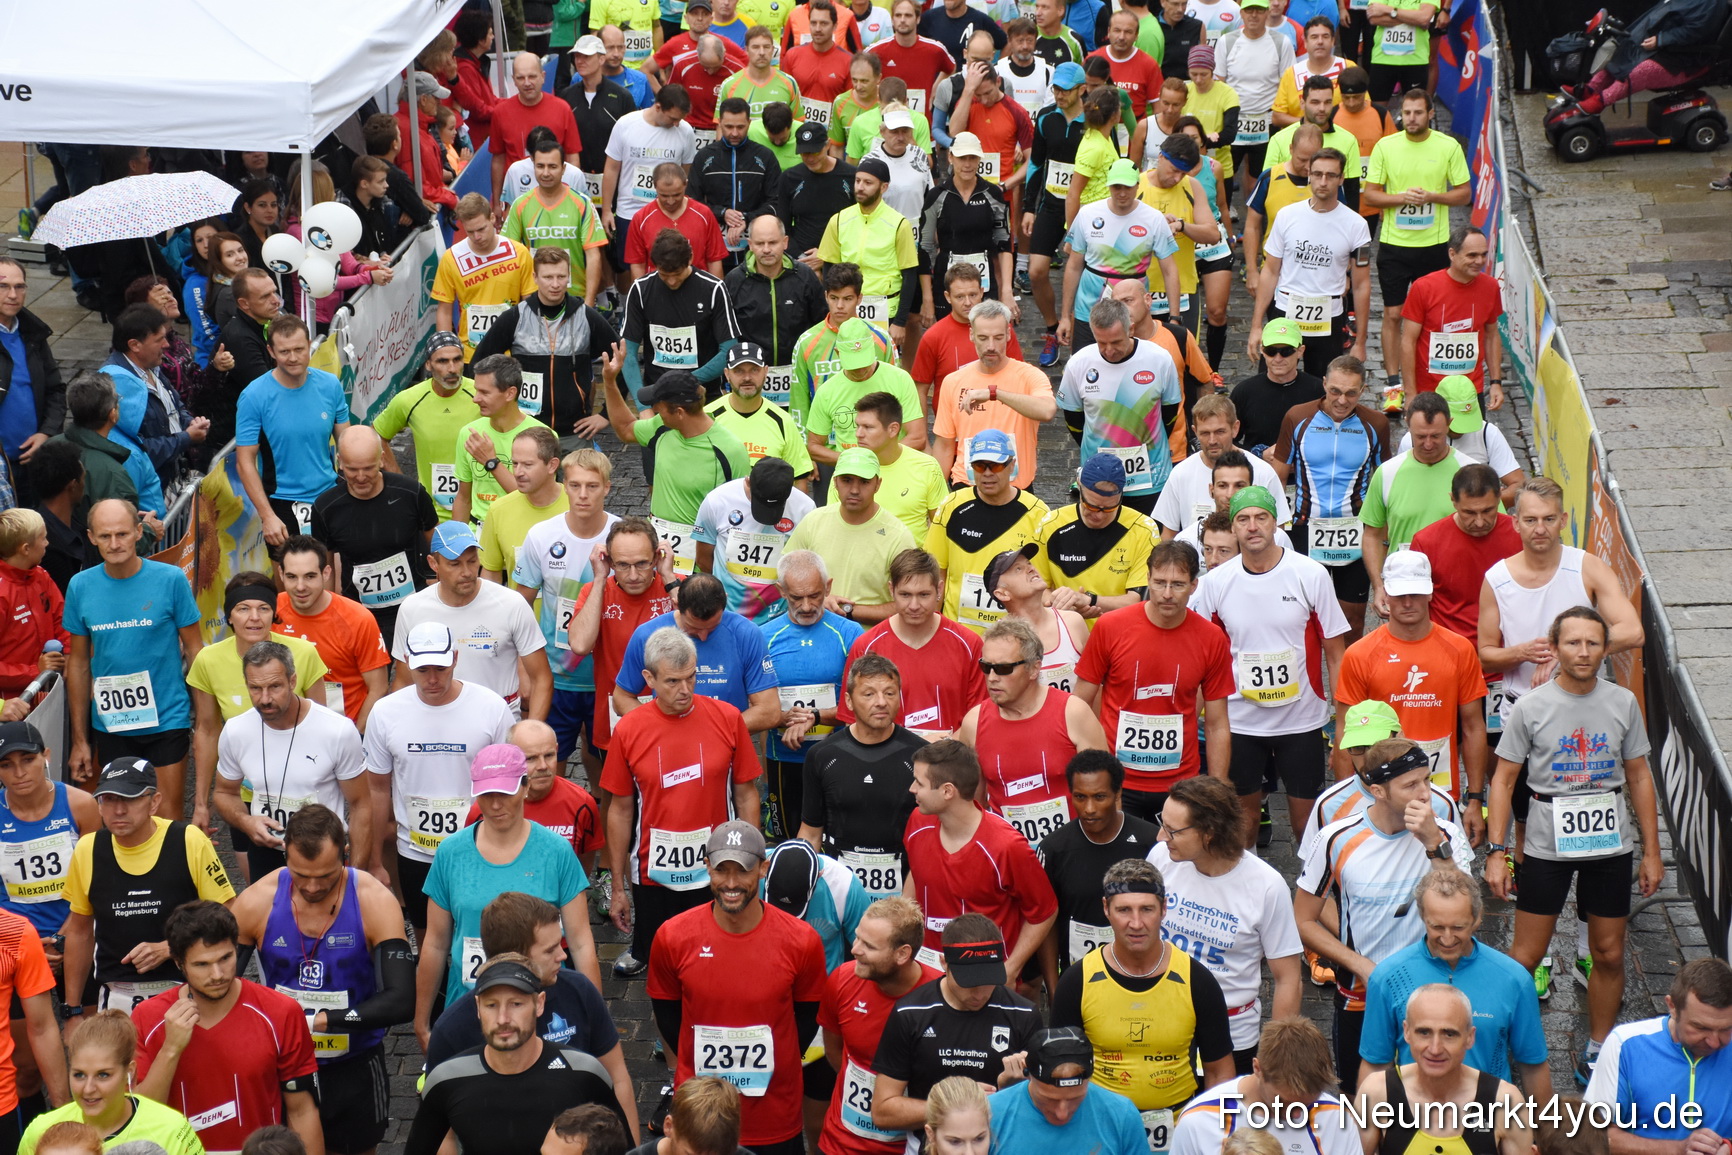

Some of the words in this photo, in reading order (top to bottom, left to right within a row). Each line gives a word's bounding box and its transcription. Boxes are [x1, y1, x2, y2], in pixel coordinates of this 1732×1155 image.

[626, 37, 651, 51] 2905
[1385, 30, 1414, 44] 3054
[804, 106, 827, 123] 896
[1236, 119, 1266, 132] 2428
[977, 161, 993, 176] 89
[586, 180, 600, 196] 73
[636, 174, 654, 189] 28
[526, 225, 577, 240] BOCK
[463, 272, 490, 288] MAX
[492, 261, 520, 277] BÖGL
[858, 304, 876, 320] 80
[1294, 304, 1322, 321] 272
[654, 335, 694, 353] 2854
[1435, 343, 1475, 360] 2668
[814, 359, 842, 376] BO
[1440, 361, 1466, 371] Edmund
[520, 384, 539, 401] 60
[744, 441, 767, 453] ller
[1124, 456, 1145, 473] 02
[437, 475, 459, 493] 25
[961, 527, 983, 538] Peter
[1314, 528, 1360, 548] 2752
[737, 543, 774, 565] 347
[1059, 553, 1087, 563] Markus
[1322, 550, 1351, 560] Thomas
[360, 565, 407, 594] 2713
[743, 567, 762, 578] Sepp
[377, 590, 401, 603] Marco
[977, 611, 998, 622] Peter
[91, 617, 153, 632] www.hasit.de
[1250, 664, 1290, 687] 313
[99, 685, 150, 711] 3069
[1258, 689, 1286, 700] Martin
[1389, 692, 1436, 704] funrunners
[1402, 698, 1442, 708] neumarkt
[912, 710, 930, 723] DEHN
[1123, 727, 1178, 751] 2588
[1130, 752, 1167, 765] Berthold
[1563, 761, 1609, 771] FINISHER
[672, 769, 692, 782] DEHN
[1563, 771, 1613, 783] INTERSPORT
[1016, 780, 1034, 790] DEHN
[418, 810, 458, 834] 293
[1562, 807, 1616, 835] 3026
[655, 845, 706, 869] 2404
[14, 852, 63, 881] 133
[670, 871, 693, 883] Ernst
[112, 902, 126, 910] LLC
[127, 899, 162, 908] Marathon
[115, 906, 158, 917] Regensburg
[1178, 907, 1238, 935] STIFTUNG
[1165, 920, 1235, 950] Altstadtfestlauf
[1206, 965, 1230, 974] land.de
[727, 1028, 764, 1041] BOCK
[326, 1037, 339, 1049] K.
[702, 1043, 768, 1070] 2372
[938, 1048, 952, 1057] LLC
[953, 1048, 988, 1059] Marathon
[1143, 1050, 1180, 1062] RÖDL
[942, 1057, 985, 1070] Regensburg
[720, 1074, 754, 1088] Oliver
[847, 1079, 873, 1113] 23
[201, 1110, 223, 1125] DEHN
